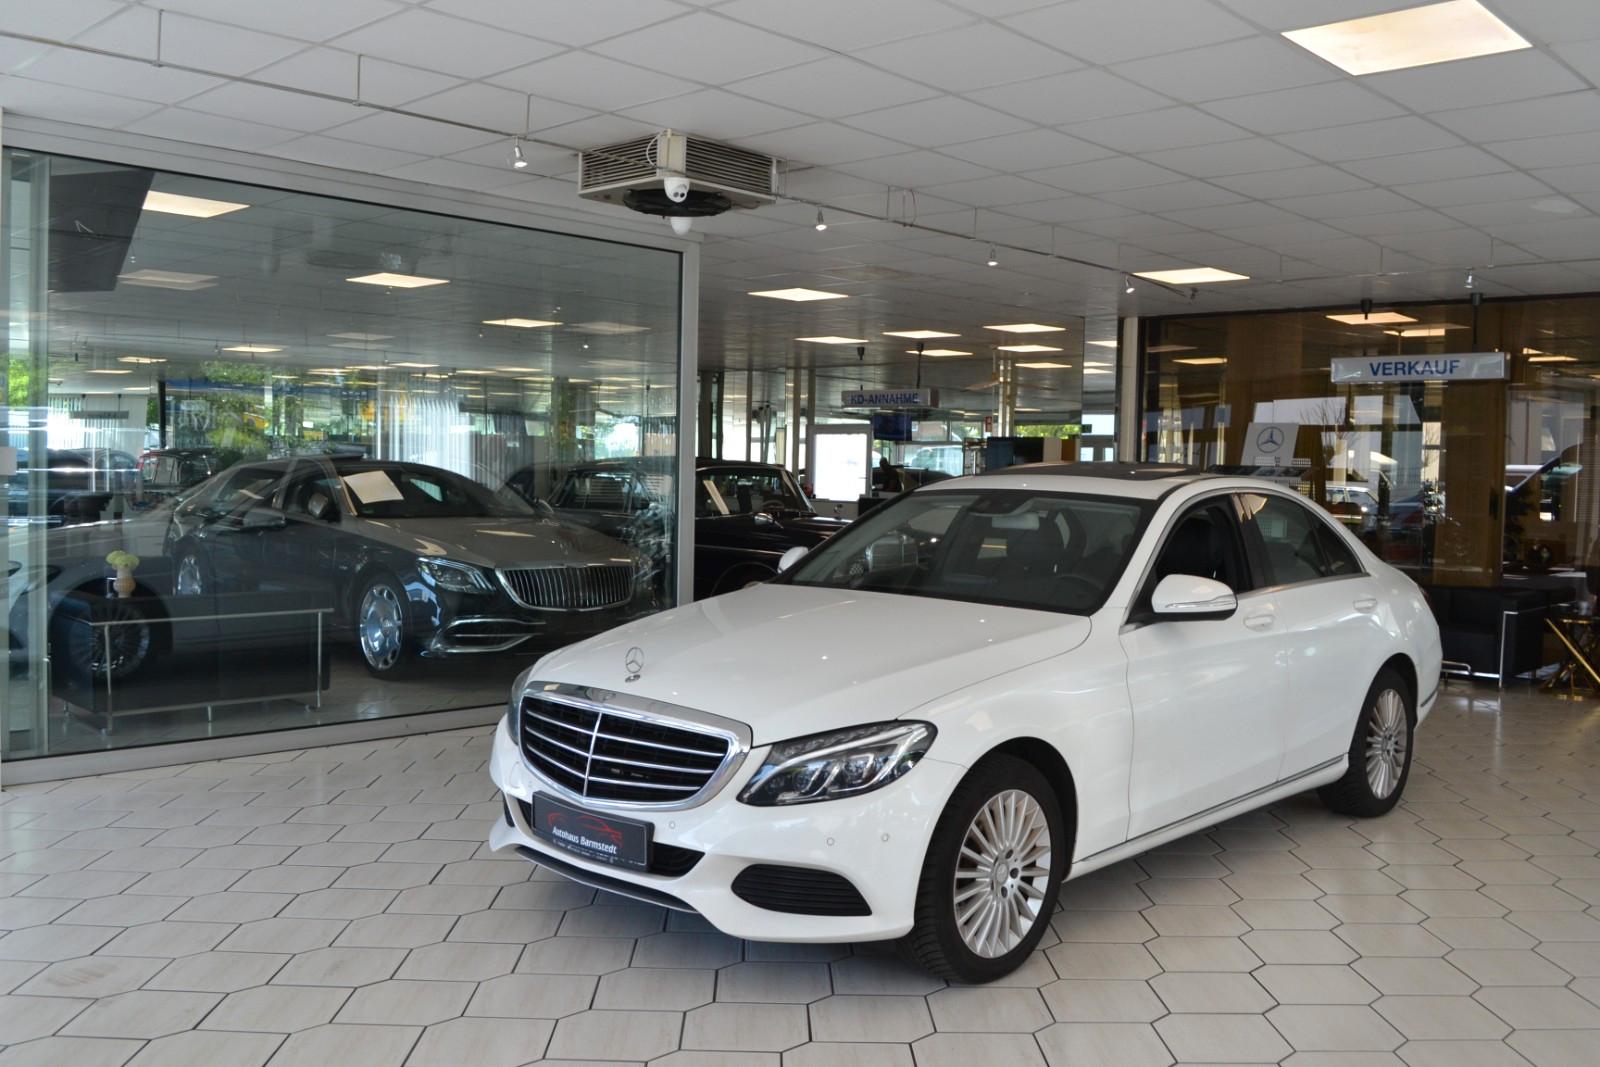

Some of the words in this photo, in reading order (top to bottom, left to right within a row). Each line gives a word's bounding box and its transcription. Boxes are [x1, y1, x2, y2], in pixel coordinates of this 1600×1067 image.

[1369, 360, 1460, 377] VERKAUF
[850, 392, 919, 405] KD-ANNAHME
[552, 826, 579, 844] Autohaus
[580, 836, 617, 854] Barmstedt
